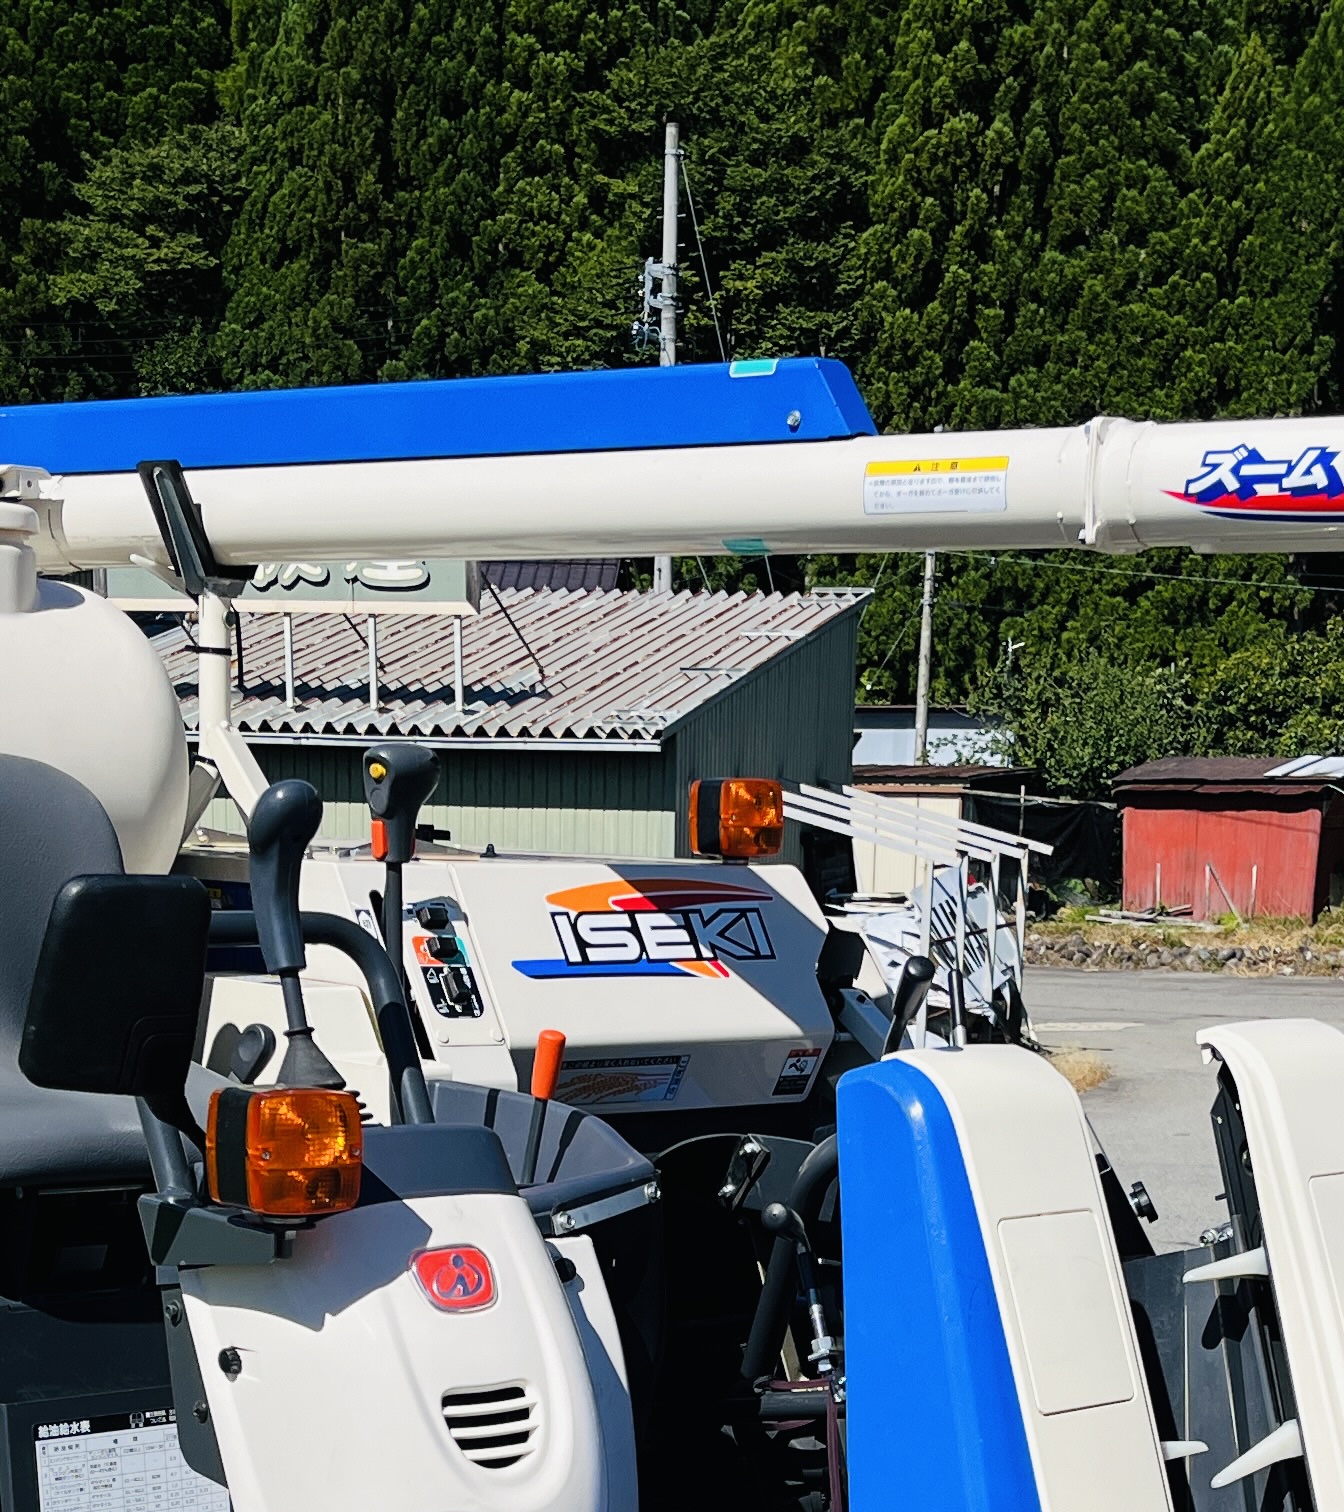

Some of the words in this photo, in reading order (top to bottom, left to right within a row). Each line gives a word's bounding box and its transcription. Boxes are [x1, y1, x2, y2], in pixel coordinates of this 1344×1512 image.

[1186, 443, 1342, 499] ズーム
[550, 907, 776, 967] ISEKI
